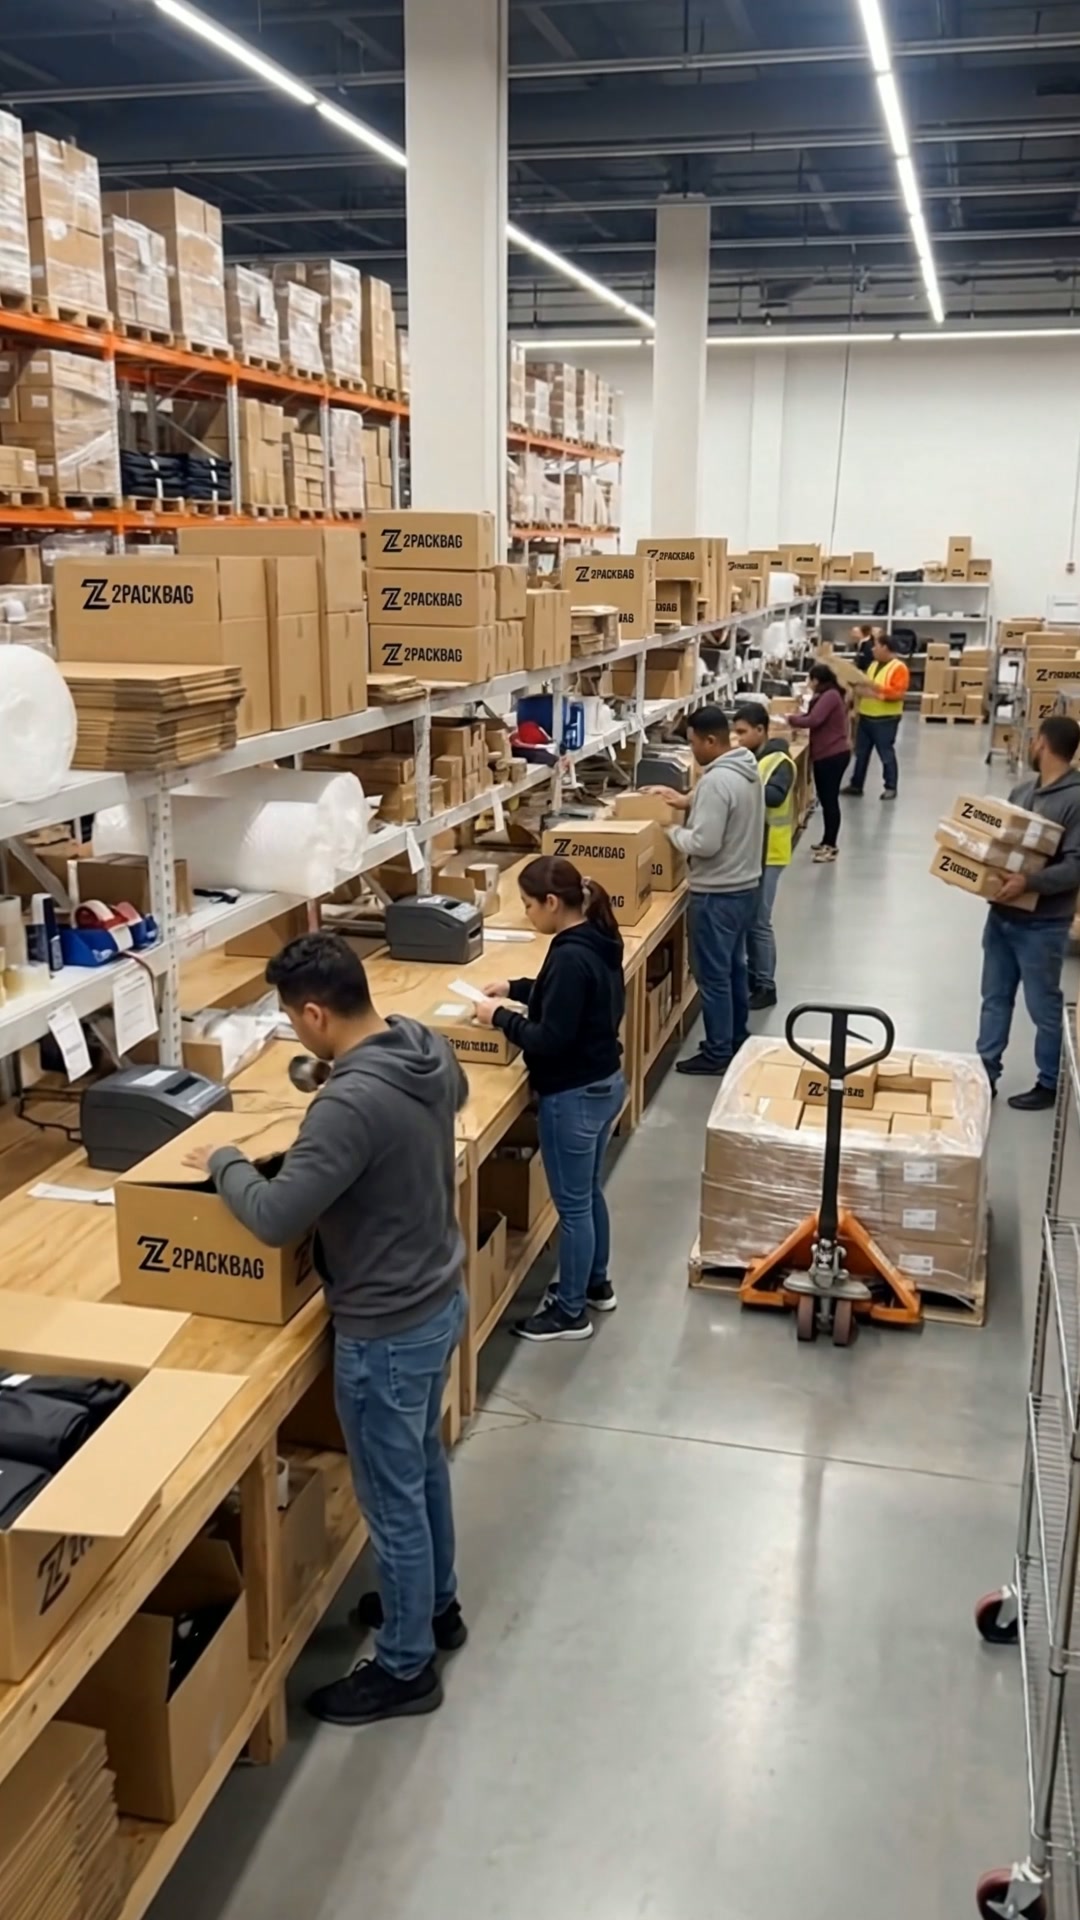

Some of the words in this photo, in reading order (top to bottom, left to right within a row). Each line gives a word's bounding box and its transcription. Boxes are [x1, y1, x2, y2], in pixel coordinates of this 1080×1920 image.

[403, 534, 463, 549] 2PACKBAG
[659, 551, 695, 561] 2PACKBAG
[590, 569, 635, 580] 2PACKBAG
[111, 584, 194, 605] 2PACKBAG
[403, 592, 463, 607] 2PACKBAG
[404, 647, 463, 663] 2PACKBAG
[571, 844, 626, 859] 2PACKBAG
[172, 1247, 265, 1280] 2PACKBAG
